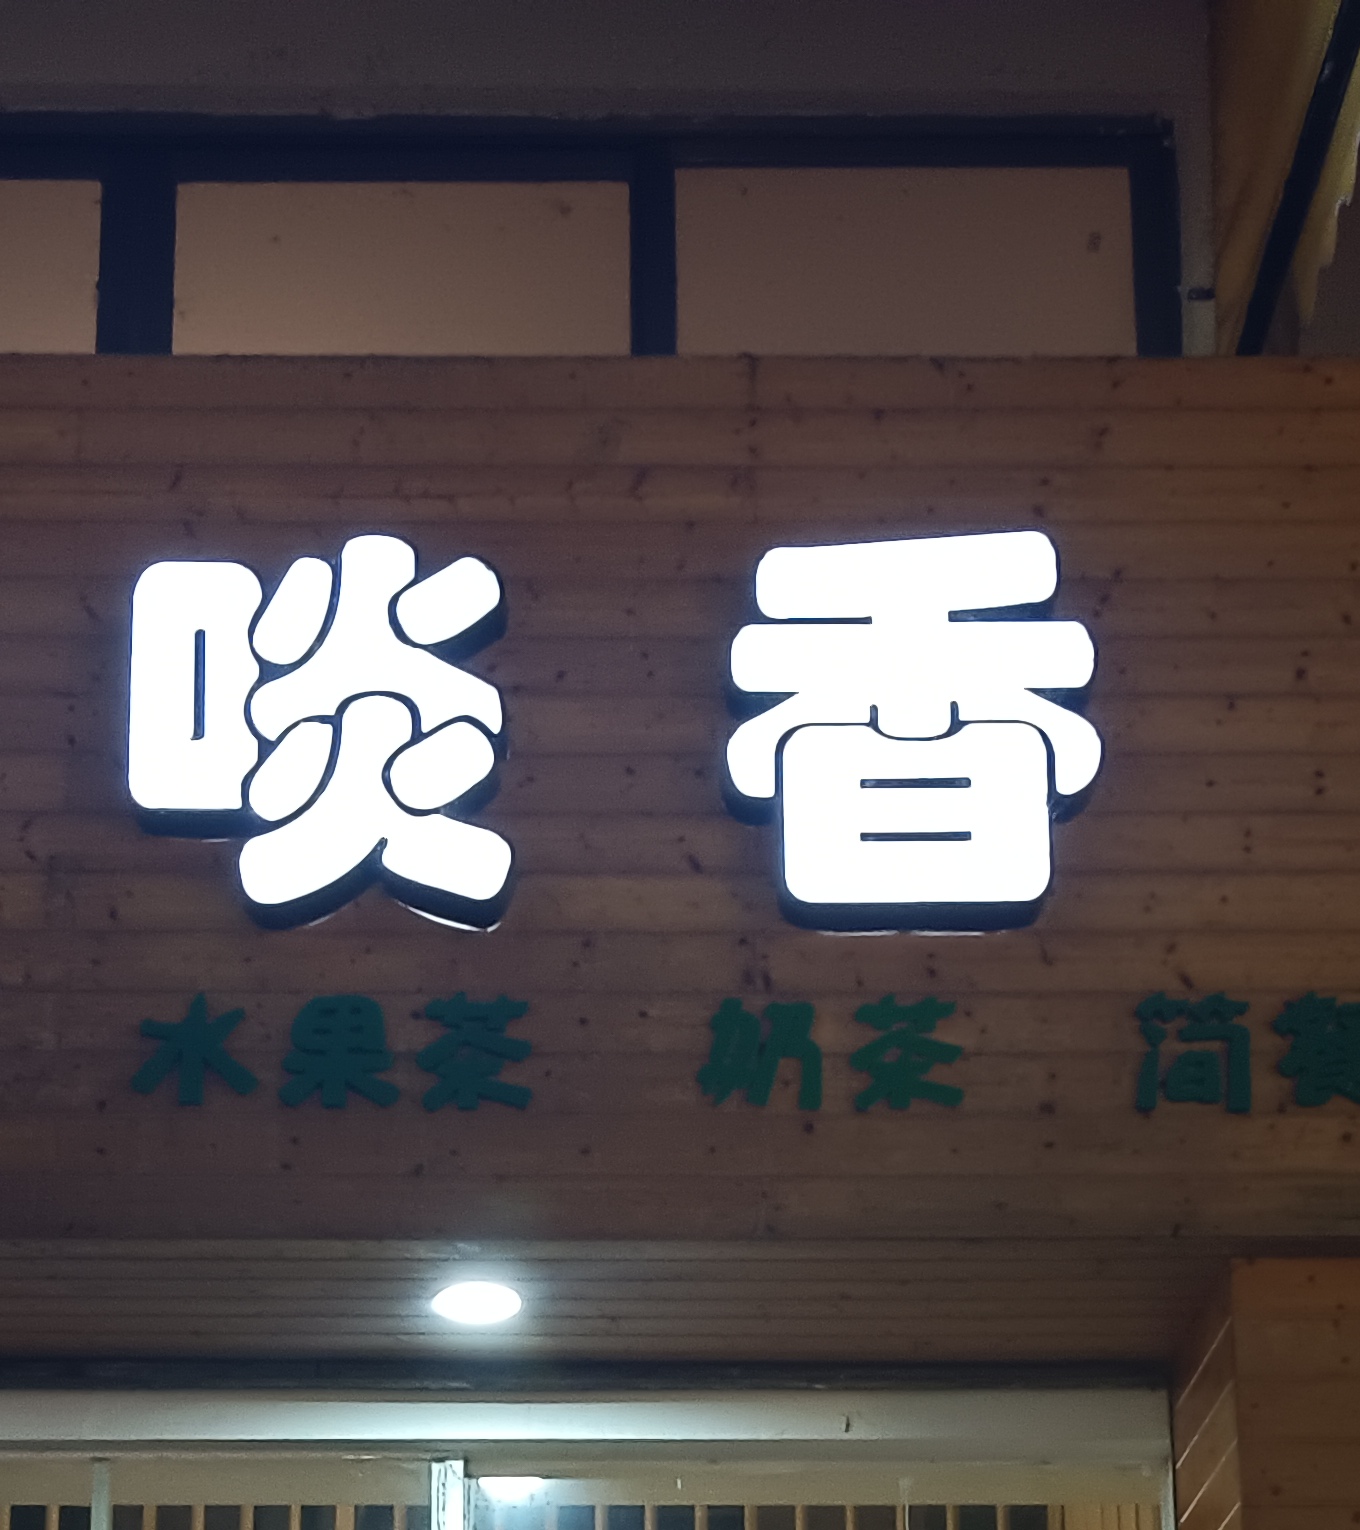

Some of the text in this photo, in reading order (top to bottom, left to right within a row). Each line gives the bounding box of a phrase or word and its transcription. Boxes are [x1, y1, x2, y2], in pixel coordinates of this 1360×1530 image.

[129, 991, 533, 1111] 水果茶
[696, 996, 966, 1112] 奶茶
